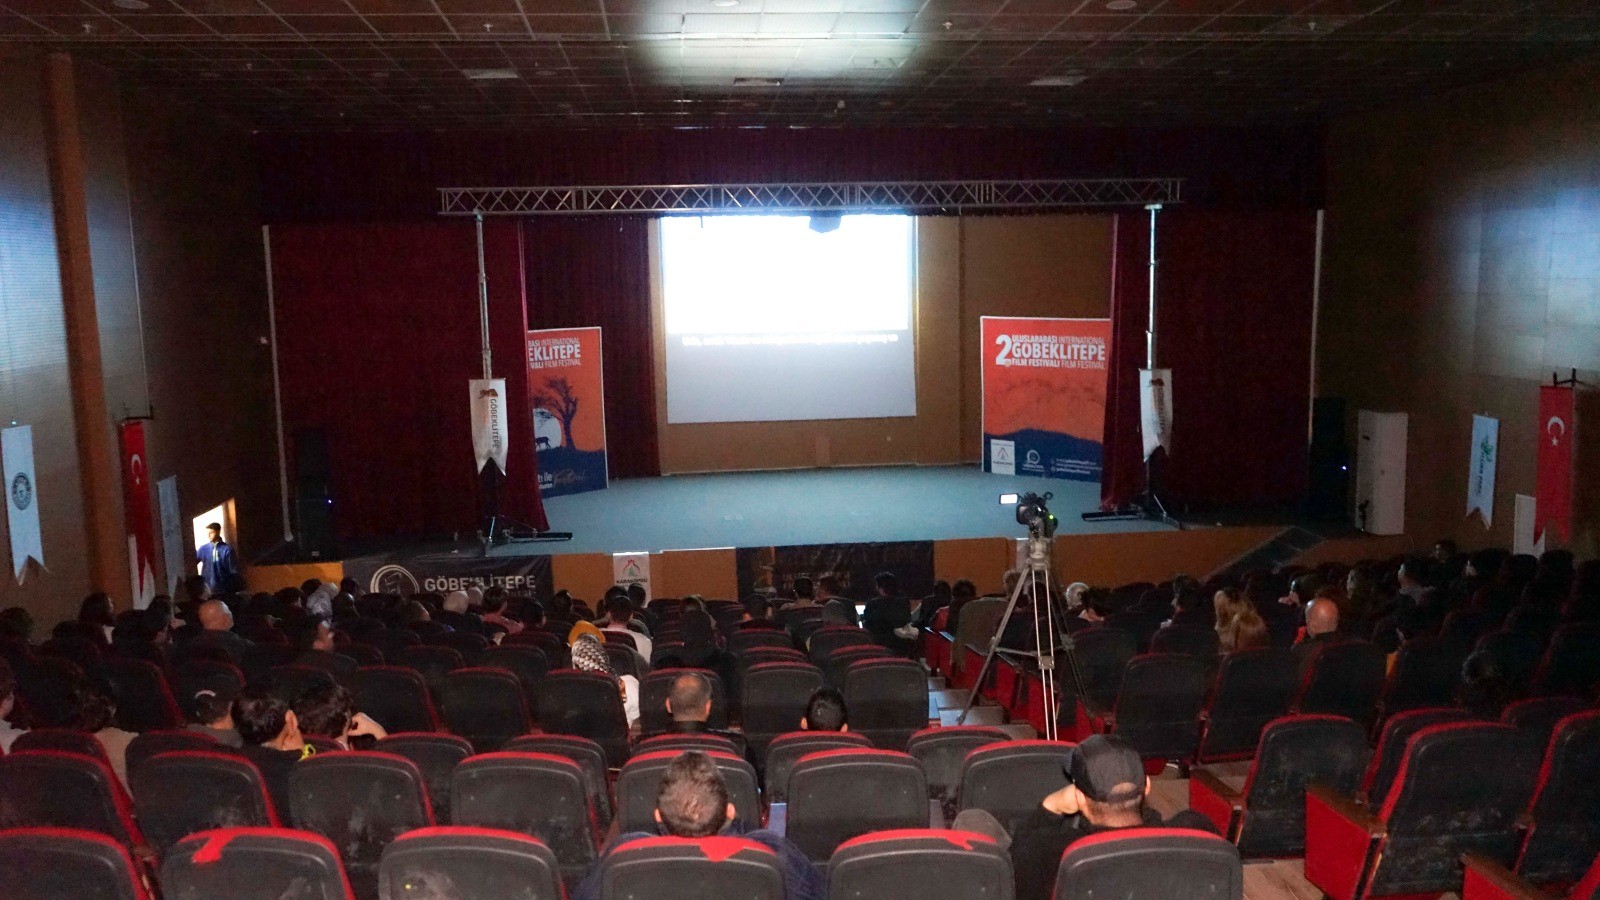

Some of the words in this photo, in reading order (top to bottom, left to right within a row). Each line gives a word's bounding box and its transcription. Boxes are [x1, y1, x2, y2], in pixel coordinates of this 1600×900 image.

[541, 337, 579, 347] INTERNATIONAL
[1059, 336, 1104, 345] INTERNATIONAL
[1078, 361, 1105, 370] FESTIVAL
[424, 573, 536, 592] GÖBELİTEPE
